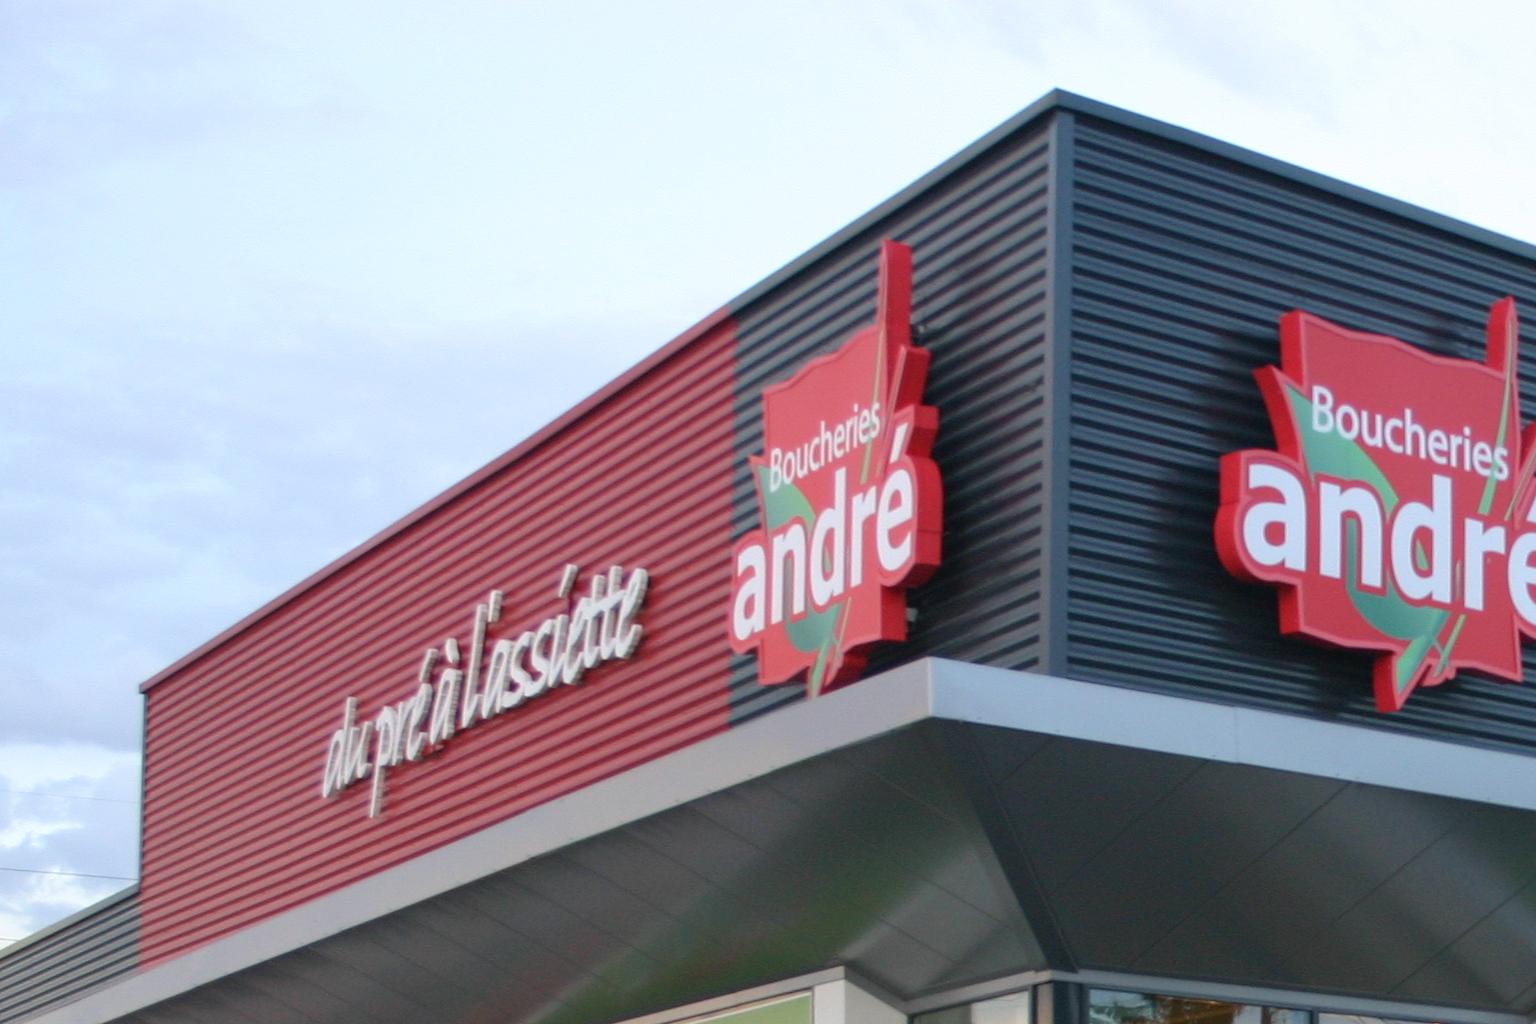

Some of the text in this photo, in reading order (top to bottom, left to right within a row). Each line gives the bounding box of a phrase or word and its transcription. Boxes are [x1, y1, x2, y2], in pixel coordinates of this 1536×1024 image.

[769, 401, 881, 493] Boucheries
[1311, 384, 1509, 481] Boucheries
[733, 422, 914, 641] andré
[322, 696, 372, 799] du
[369, 648, 439, 819] pré
